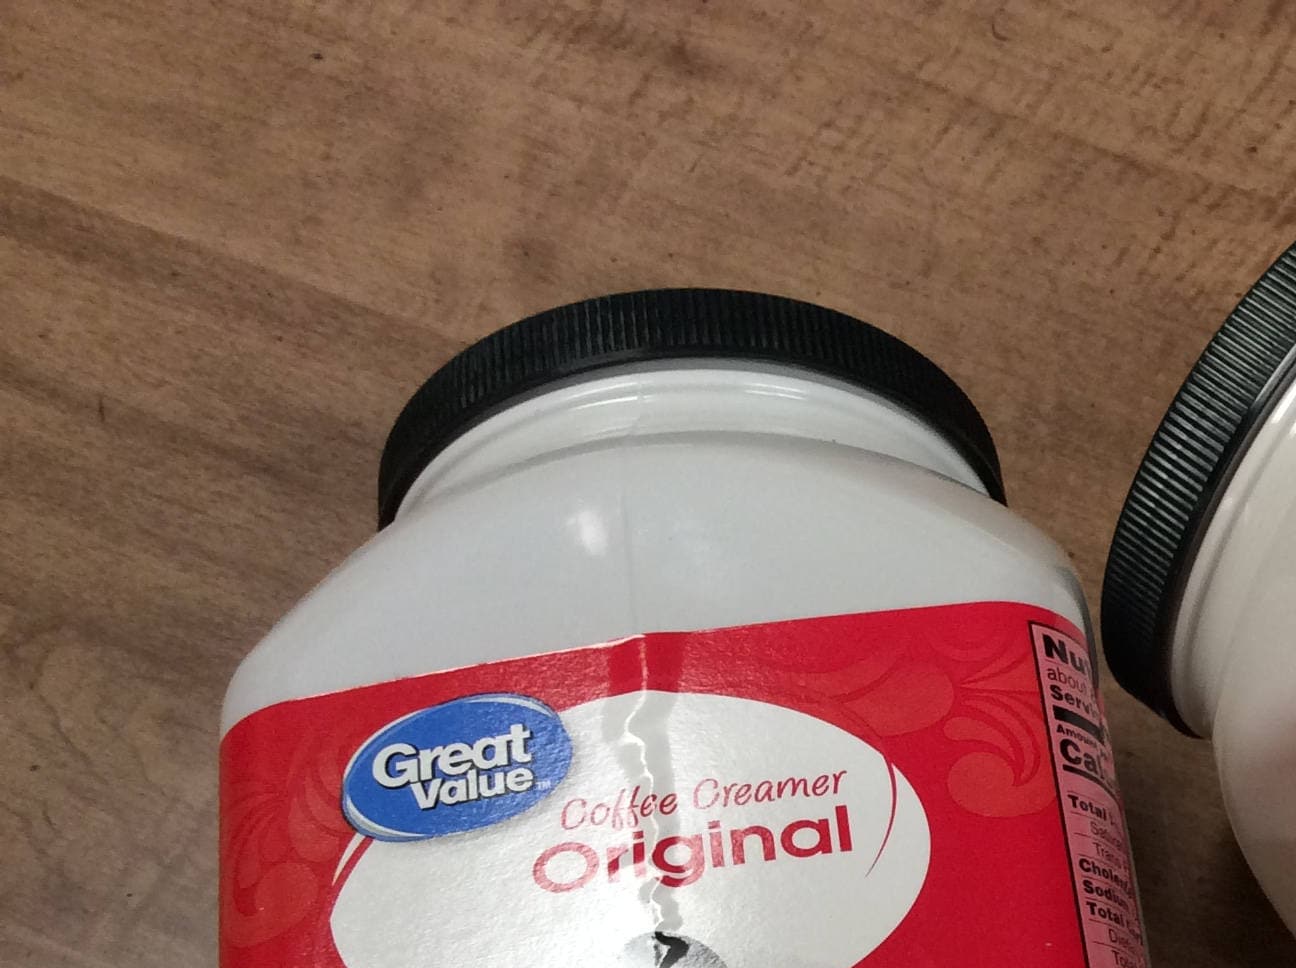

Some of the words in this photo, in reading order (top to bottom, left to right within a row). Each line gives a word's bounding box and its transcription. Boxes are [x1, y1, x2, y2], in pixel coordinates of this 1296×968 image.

[372, 723, 533, 789] Great
[409, 764, 534, 811] Value
[560, 785, 678, 832] Coffee
[694, 769, 847, 811] Creamer
[1067, 793, 1107, 820] Total
[532, 804, 853, 893] Original
[1086, 901, 1125, 926] Total
